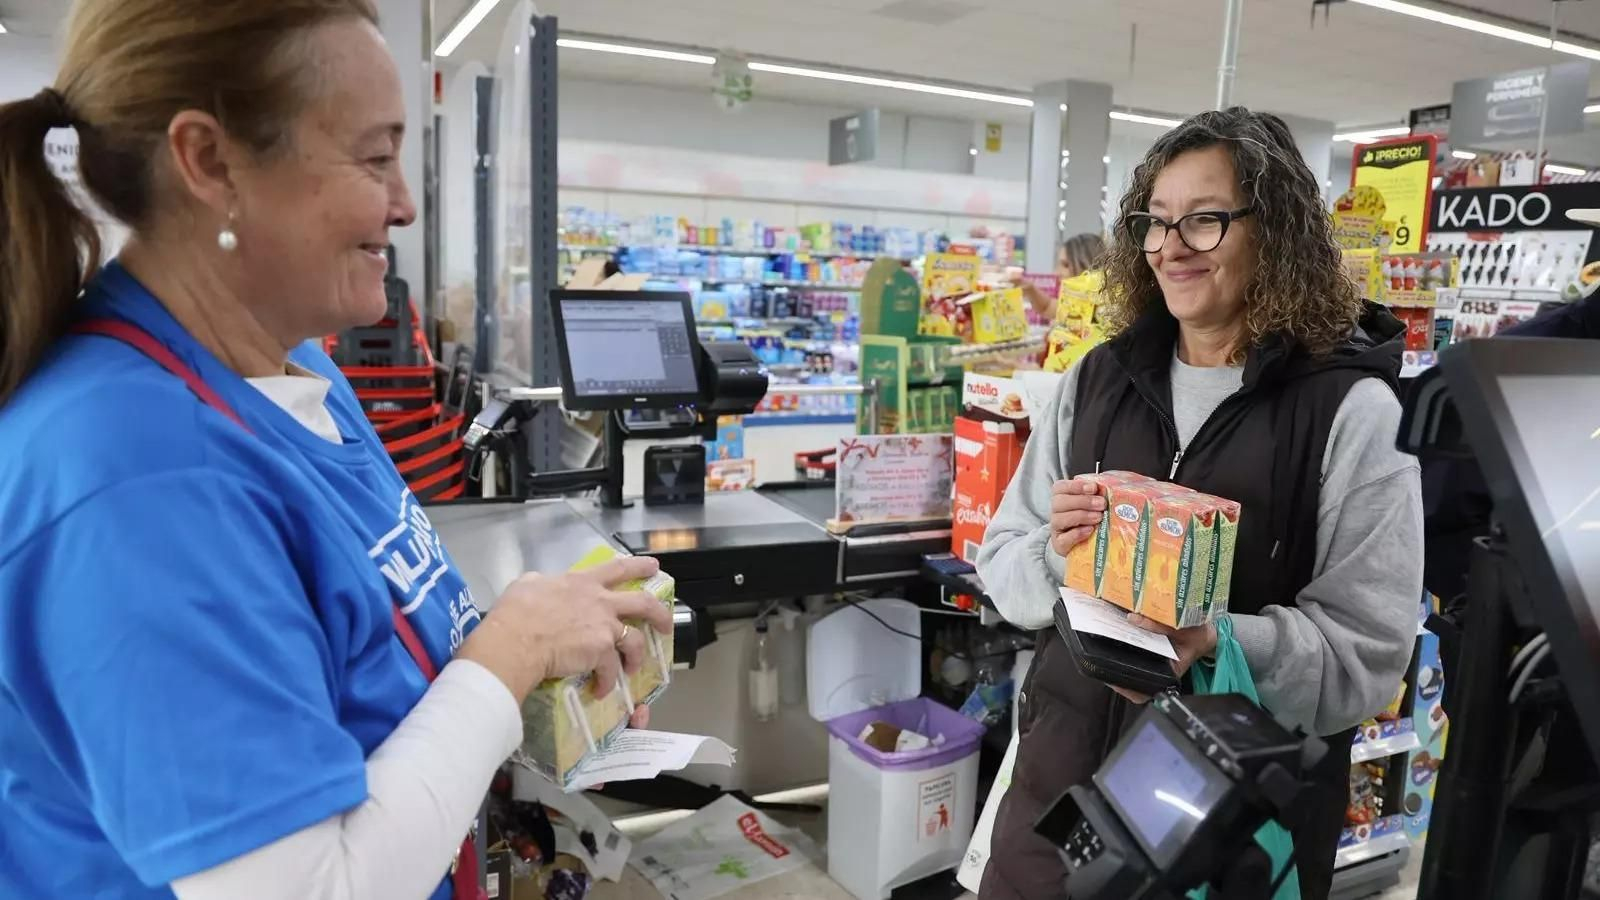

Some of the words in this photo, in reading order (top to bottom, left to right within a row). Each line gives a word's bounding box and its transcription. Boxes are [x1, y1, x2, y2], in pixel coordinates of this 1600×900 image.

[1437, 192, 1551, 228] KADO
[1395, 226, 1410, 246] 9
[967, 383, 998, 397] nutella
